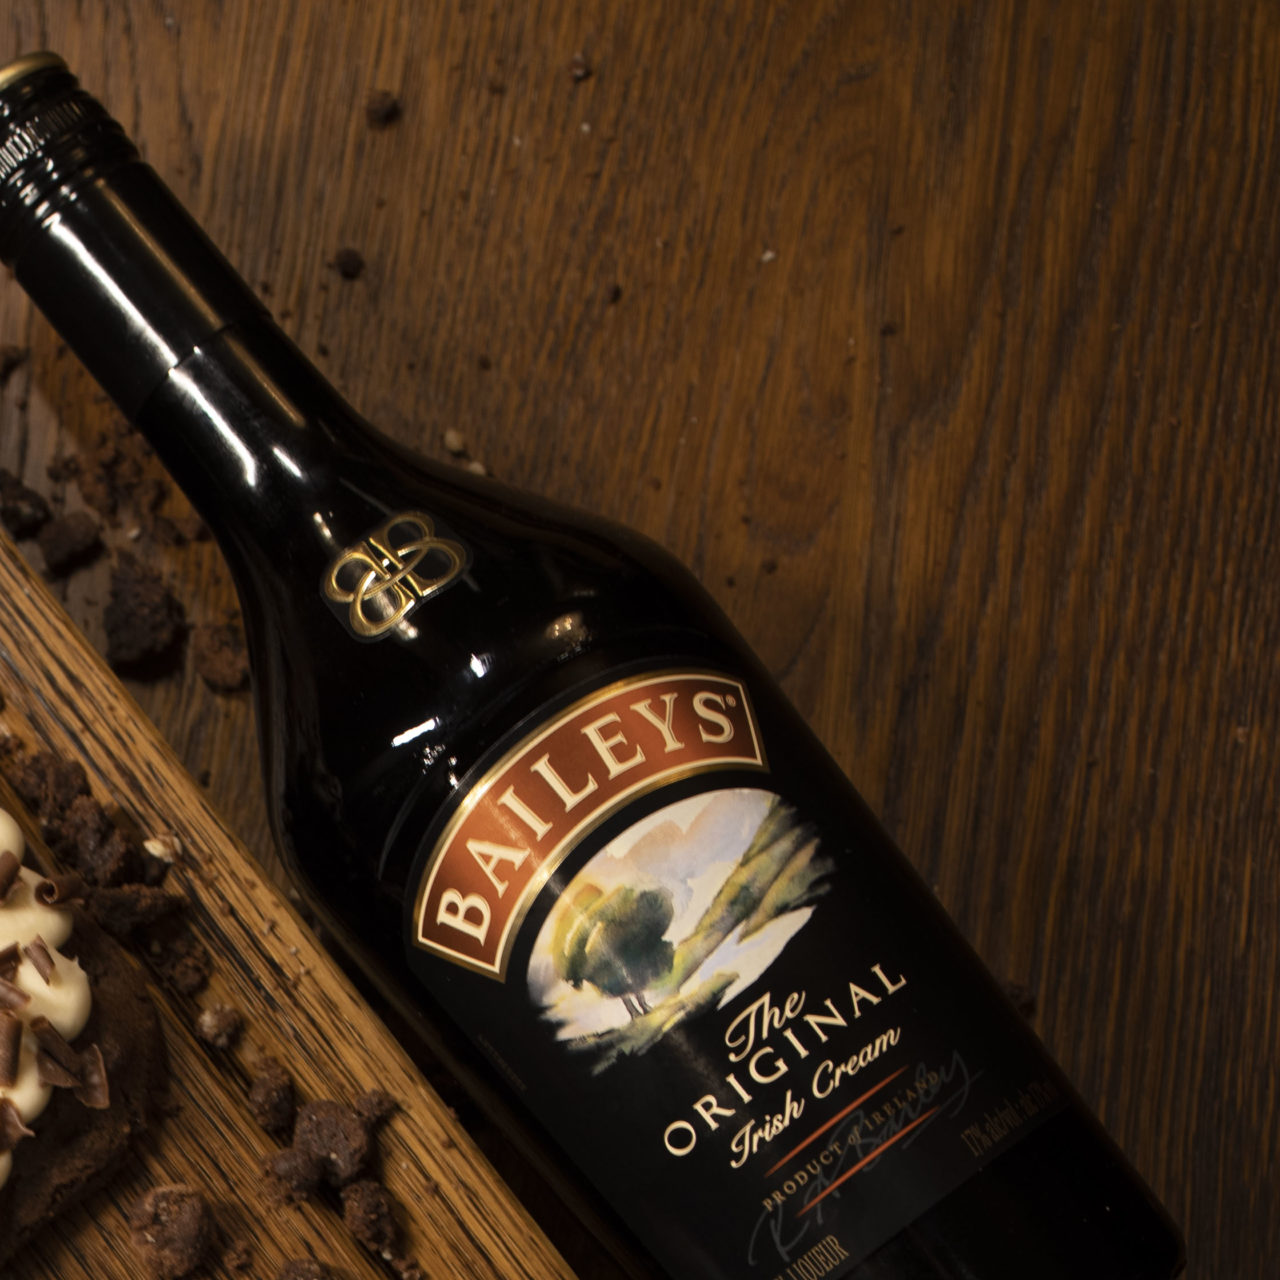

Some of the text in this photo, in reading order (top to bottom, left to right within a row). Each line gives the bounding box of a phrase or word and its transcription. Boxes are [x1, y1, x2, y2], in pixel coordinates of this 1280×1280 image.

[436, 691, 734, 947] BAILEYS
[663, 962, 907, 1157] ORIGINAL
[725, 989, 806, 1063] The
[730, 1026, 901, 1169] Irish Cream
[762, 1070, 940, 1212] PRODUCT of IRELAND
